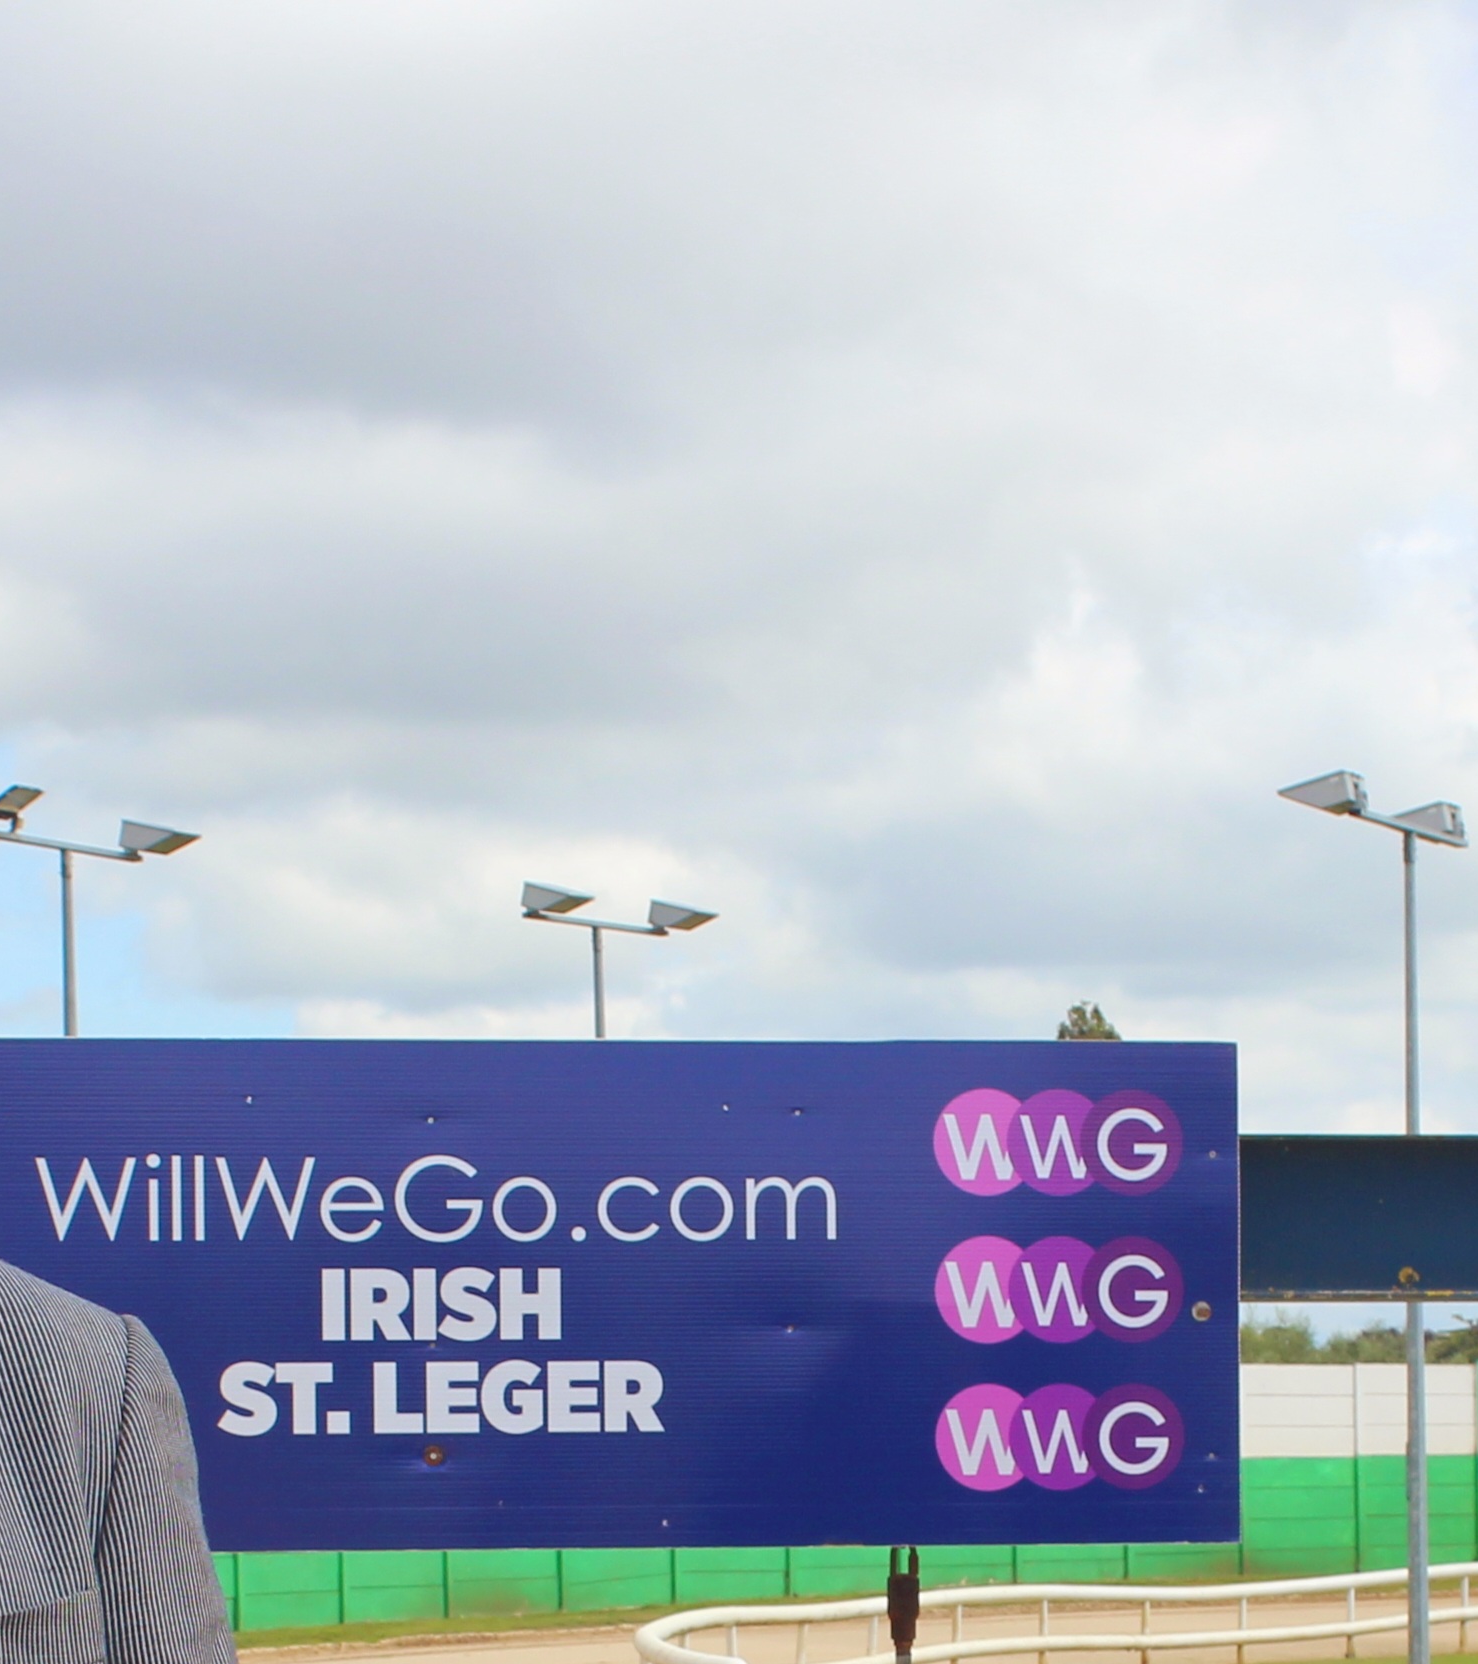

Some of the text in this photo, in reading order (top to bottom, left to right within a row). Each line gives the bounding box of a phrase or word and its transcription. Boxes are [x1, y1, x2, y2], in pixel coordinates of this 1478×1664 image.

[942, 1107, 1168, 1182] WWG
[34, 1153, 838, 1244] WillWeGo.com
[321, 1267, 562, 1342] IRISH
[943, 1254, 1170, 1328] WWG
[217, 1359, 665, 1437] ST. LEGER
[944, 1401, 1171, 1475] WWG
